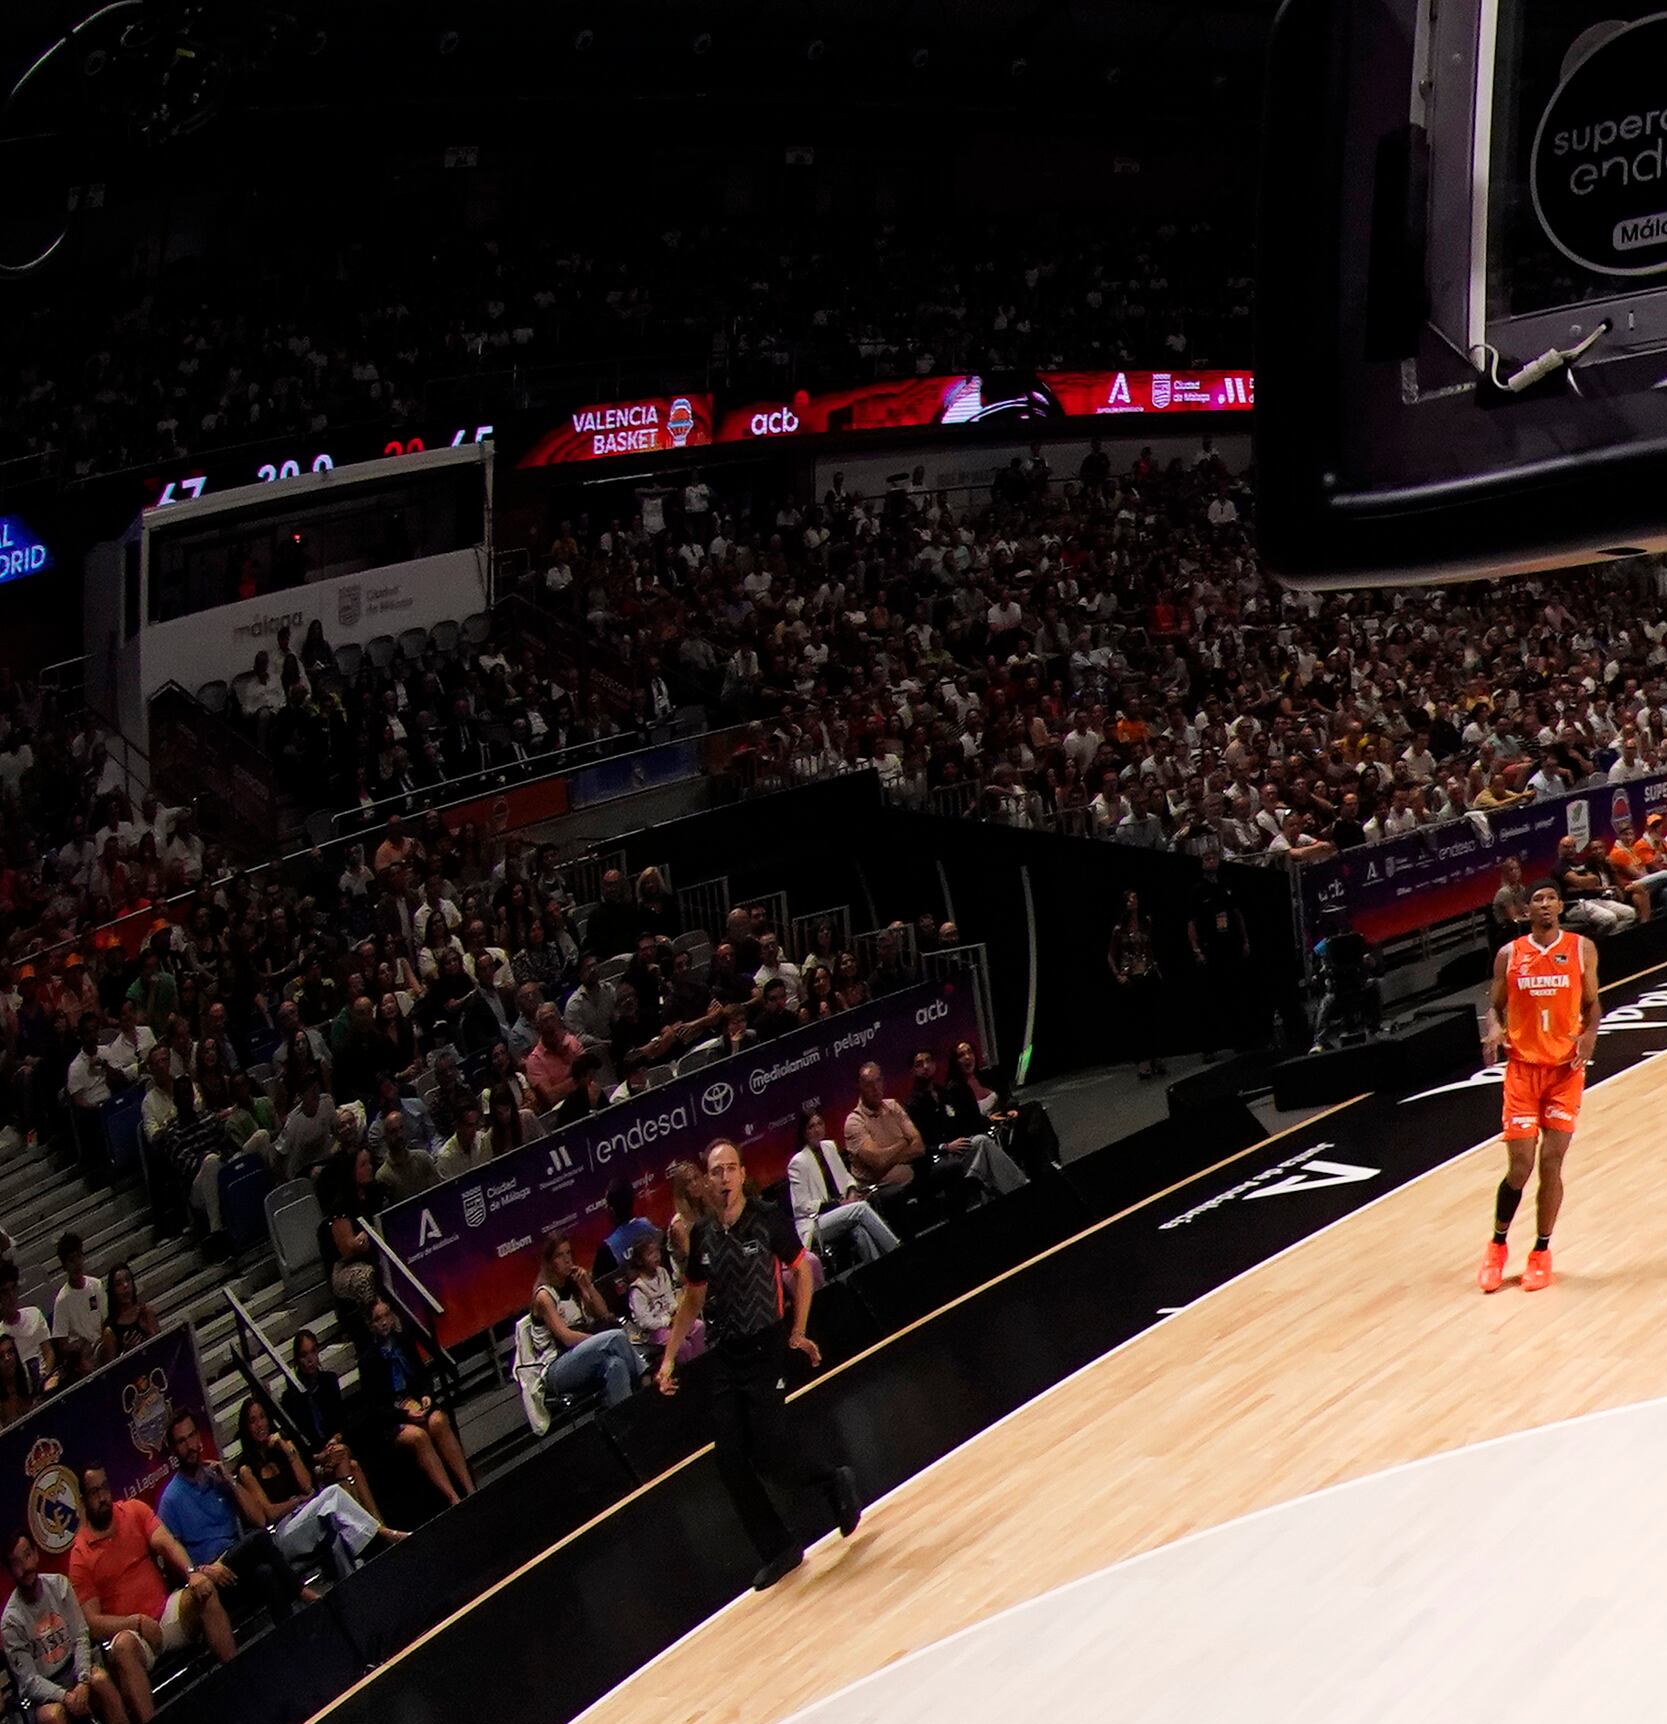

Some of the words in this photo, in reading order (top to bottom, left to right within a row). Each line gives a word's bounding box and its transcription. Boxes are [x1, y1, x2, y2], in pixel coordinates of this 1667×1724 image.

[573, 406, 659, 433] VALENCIA
[751, 407, 799, 435] acb
[593, 428, 659, 455] BASKET
[1517, 975, 1570, 990] VALENCIA
[914, 999, 950, 1026] acb
[1541, 1009, 1549, 1032] 1
[833, 1026, 876, 1057] pelayo
[596, 1105, 688, 1164] endesa
[487, 1177, 517, 1198] Ciudad
